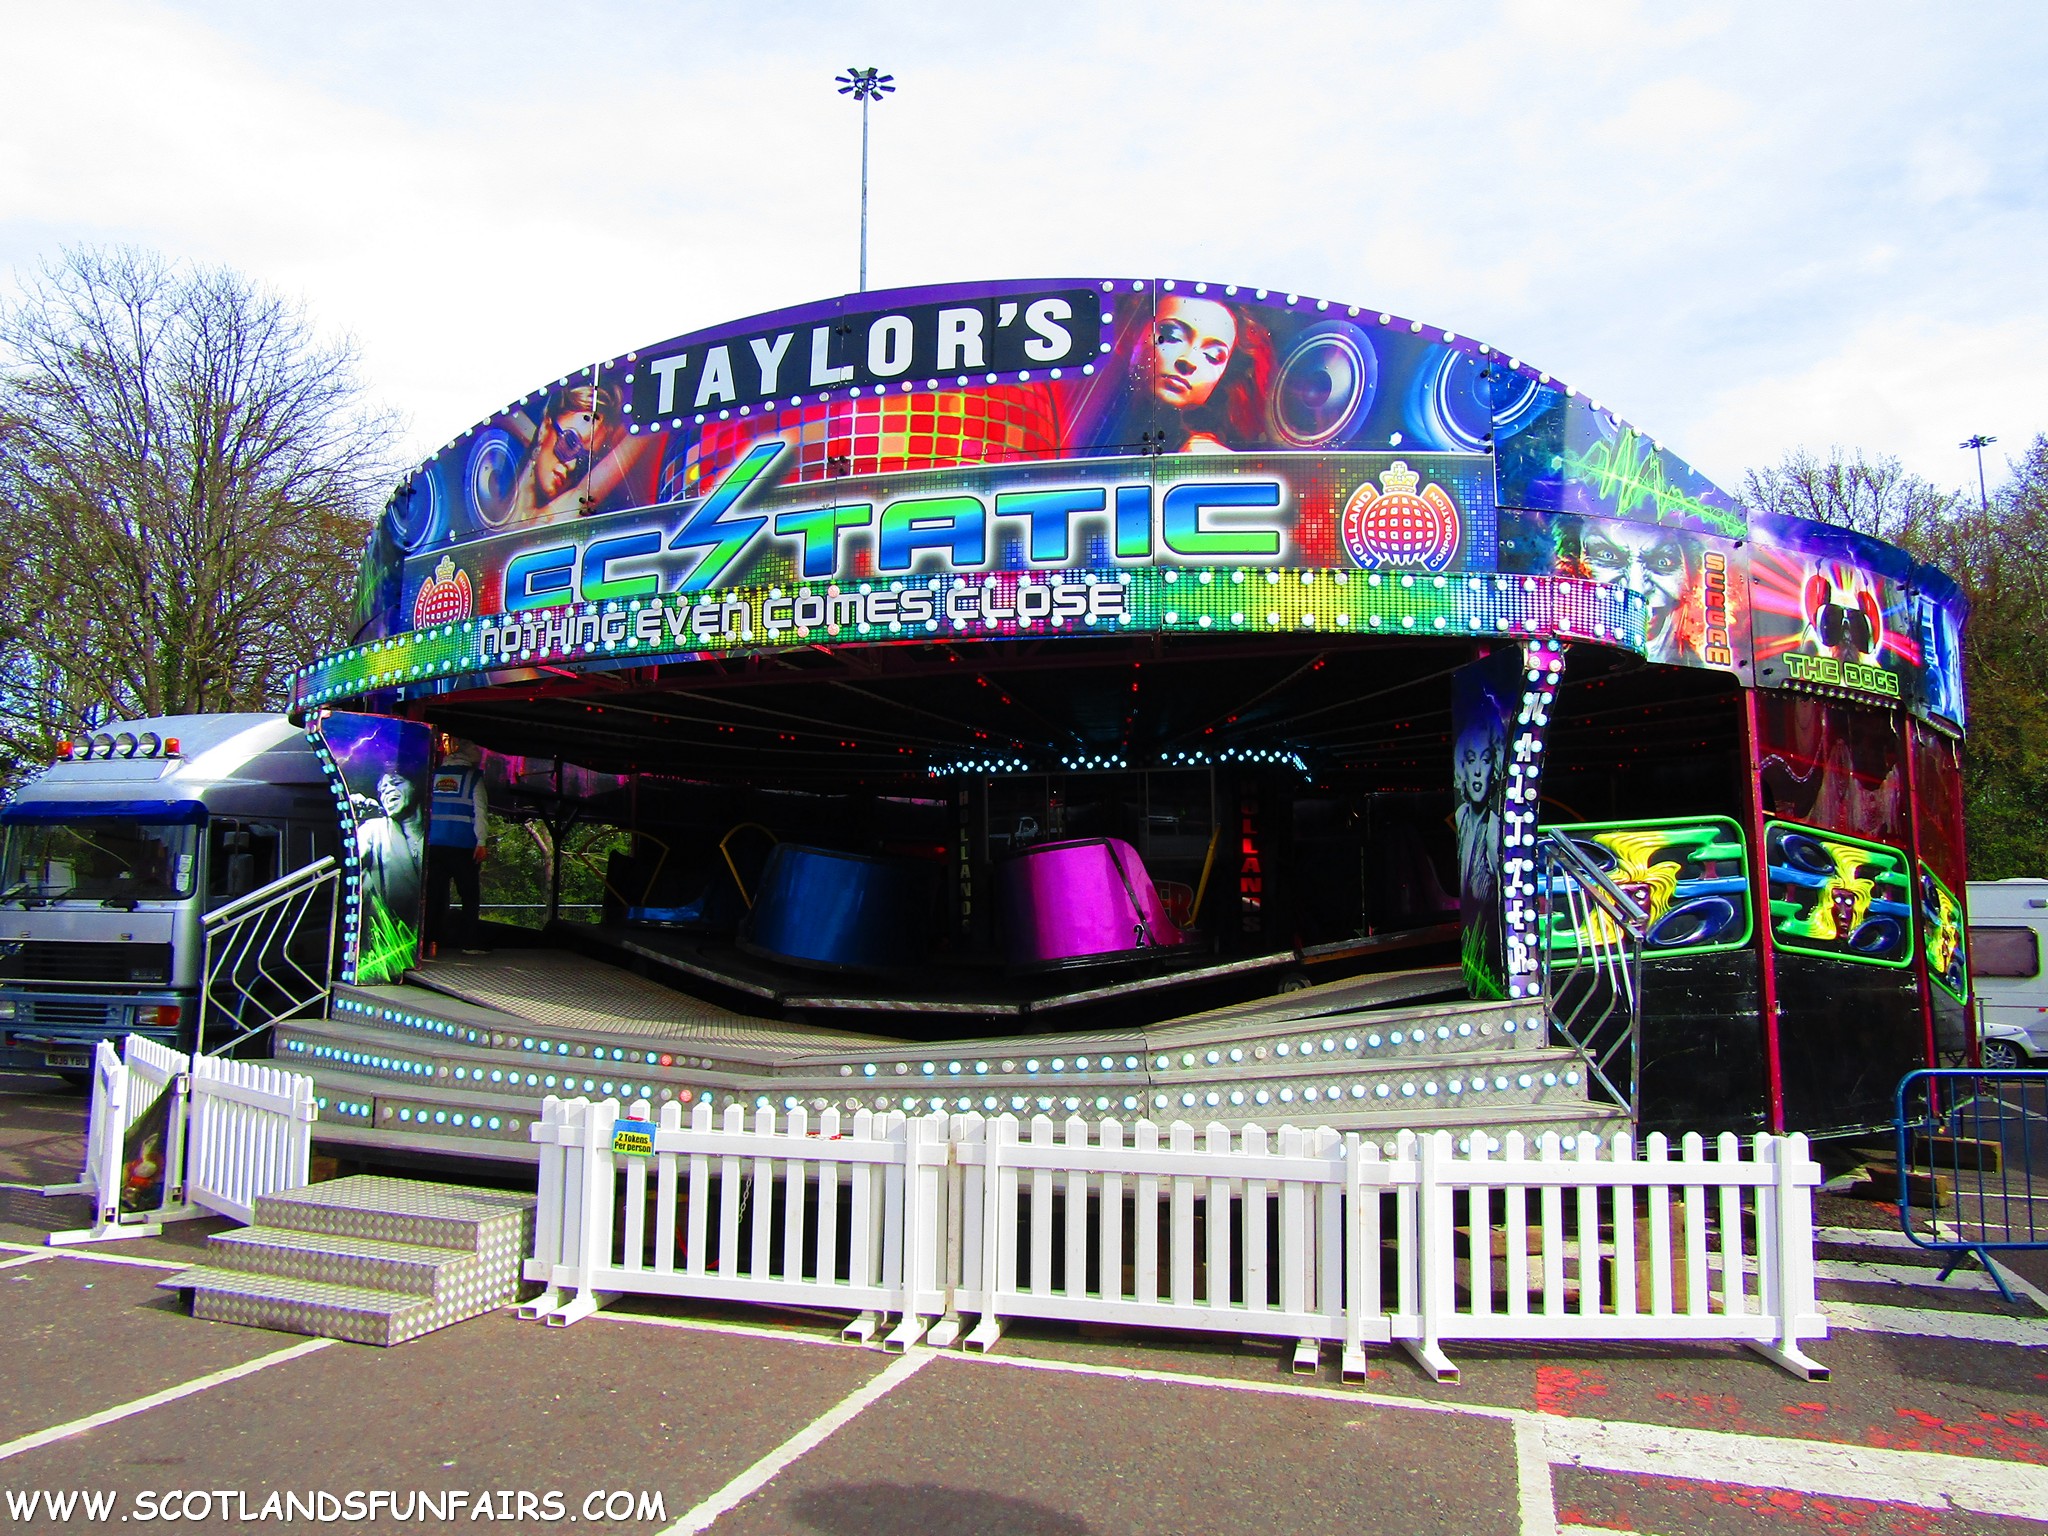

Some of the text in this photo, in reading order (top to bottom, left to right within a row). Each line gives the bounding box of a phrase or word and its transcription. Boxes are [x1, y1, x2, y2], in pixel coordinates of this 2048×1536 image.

[650, 298, 1073, 414] TAYLOR'S
[1347, 490, 1374, 567] HOLLAND
[1429, 491, 1453, 568] CORPORATION
[763, 589, 934, 629] COMES
[946, 583, 1126, 620] CLOSE
[1704, 552, 1732, 667] SCREAM
[1783, 652, 1899, 696] THE DOGS
[1507, 691, 1545, 974] WALTZER
[1133, 923, 1146, 949] 2
[614, 1142, 626, 1150] Per
[618, 1133, 649, 1144] 2 Tokens
